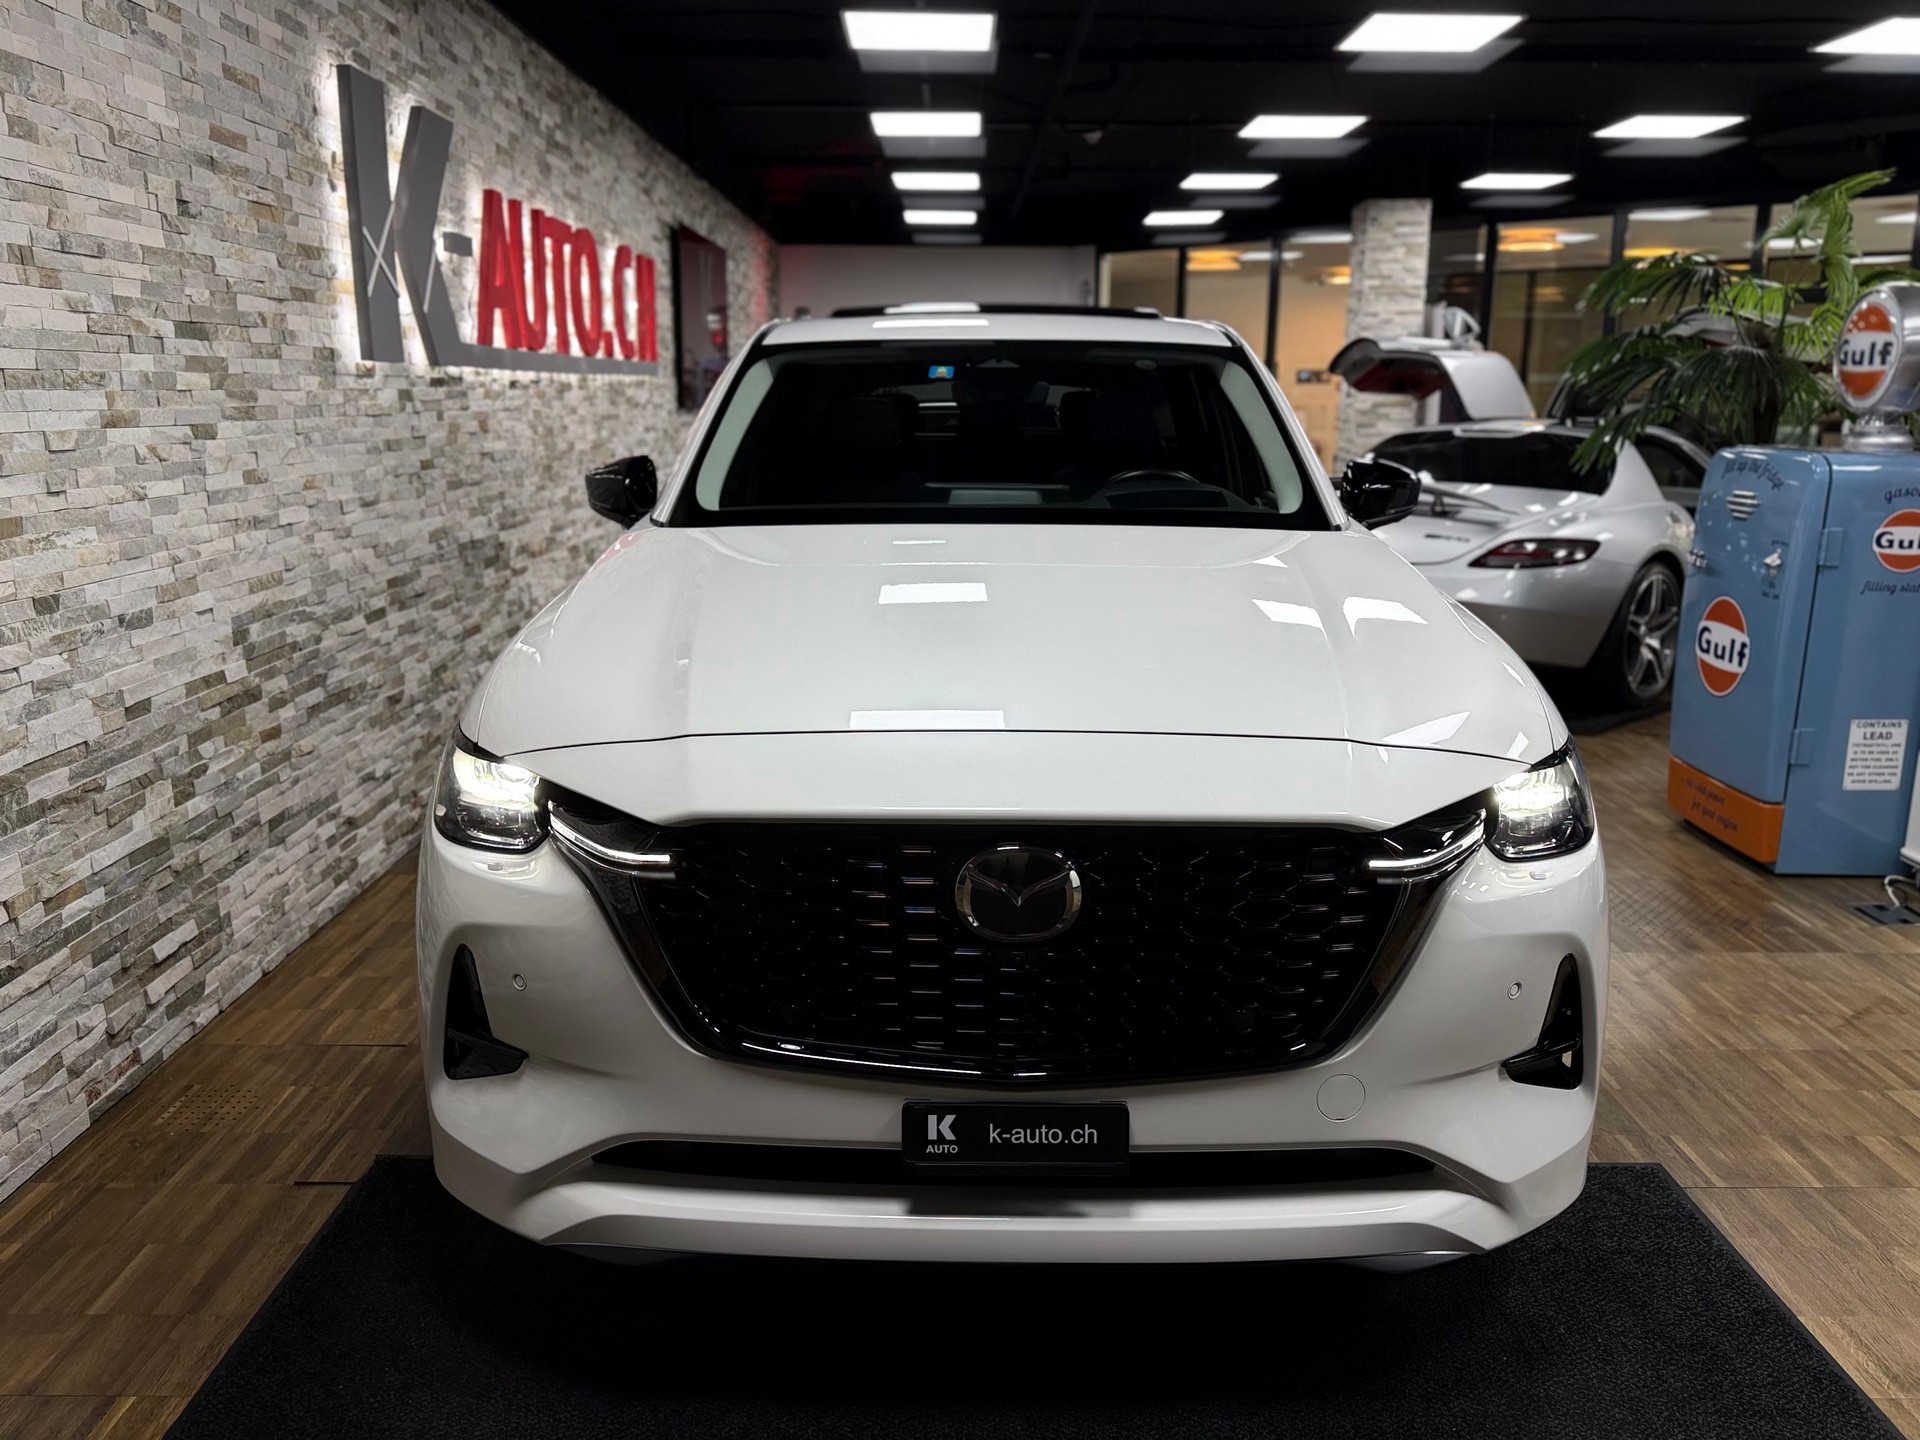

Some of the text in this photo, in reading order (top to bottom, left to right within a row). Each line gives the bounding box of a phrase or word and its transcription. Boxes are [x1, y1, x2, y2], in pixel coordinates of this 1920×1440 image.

[1840, 339, 1893, 365] Gulf
[1884, 487, 1920, 505] gaso
[1861, 581, 1897, 596] filling
[1698, 626, 1748, 668] Gulf
[1863, 731, 1893, 740] LEAD
[928, 1114, 957, 1140] K
[989, 1124, 1098, 1144] k-auto.ch
[926, 1145, 958, 1154] AUTO
